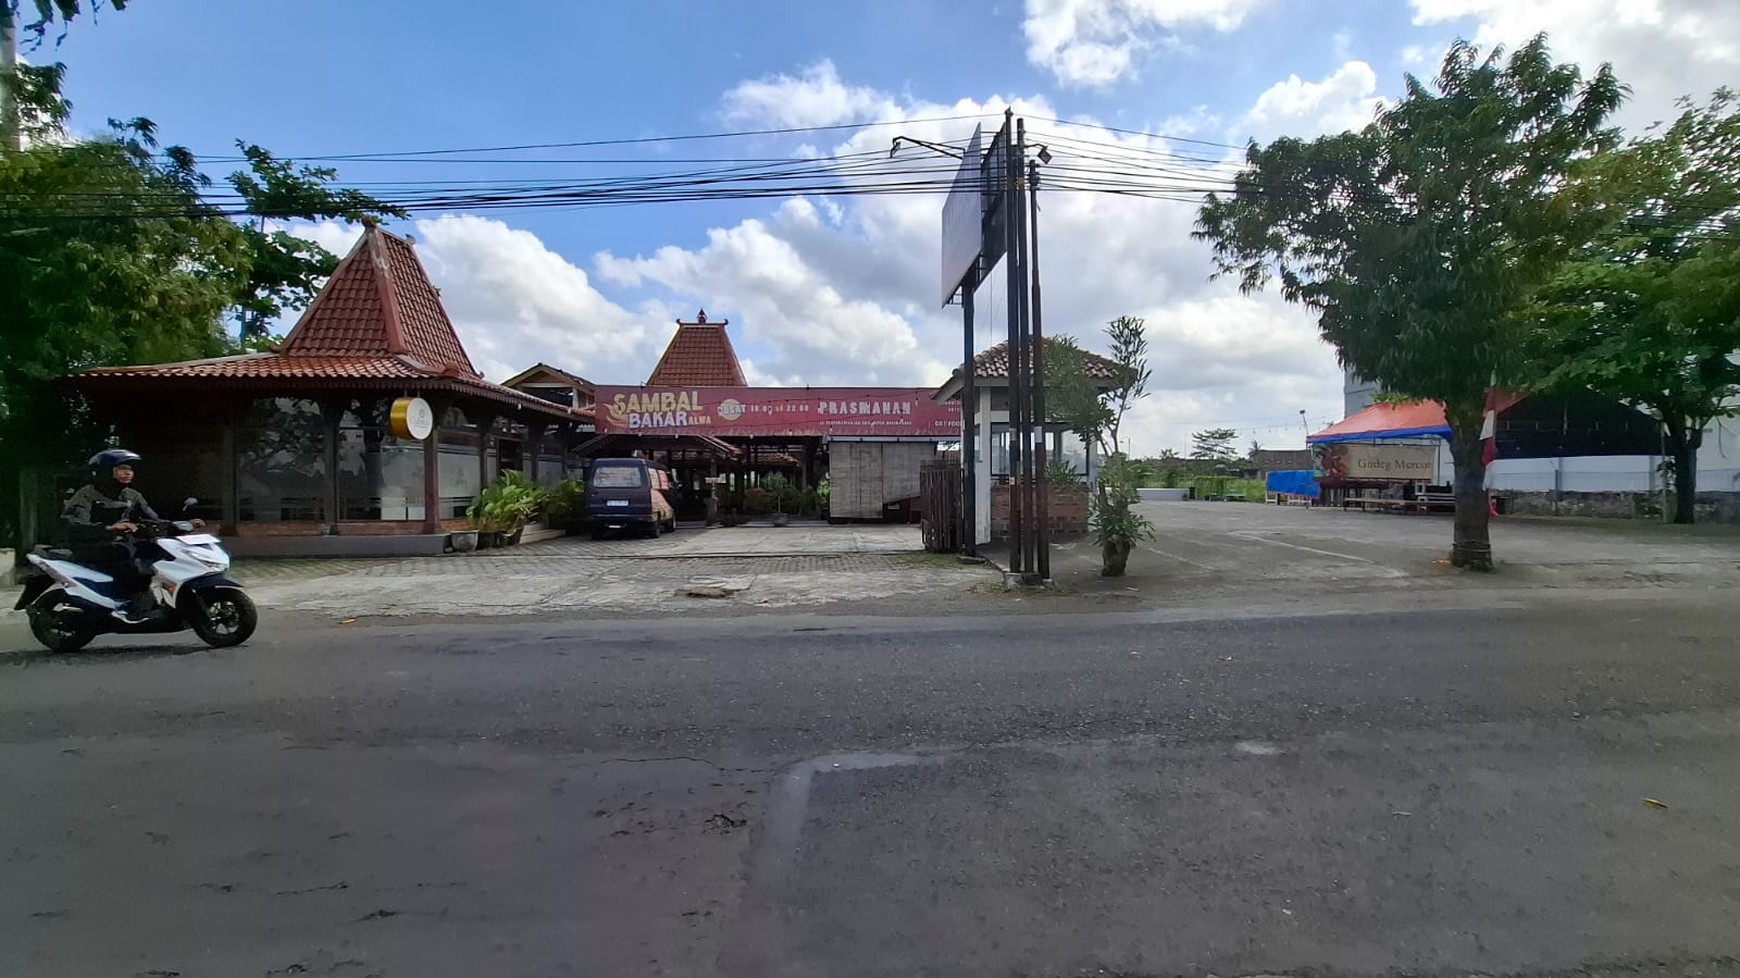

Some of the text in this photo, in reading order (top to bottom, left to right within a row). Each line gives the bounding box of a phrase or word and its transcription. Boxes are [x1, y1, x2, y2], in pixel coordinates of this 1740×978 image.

[613, 391, 704, 413] SAMBAL
[819, 401, 911, 414] PRASMANAN
[629, 410, 688, 429] BAKAR
